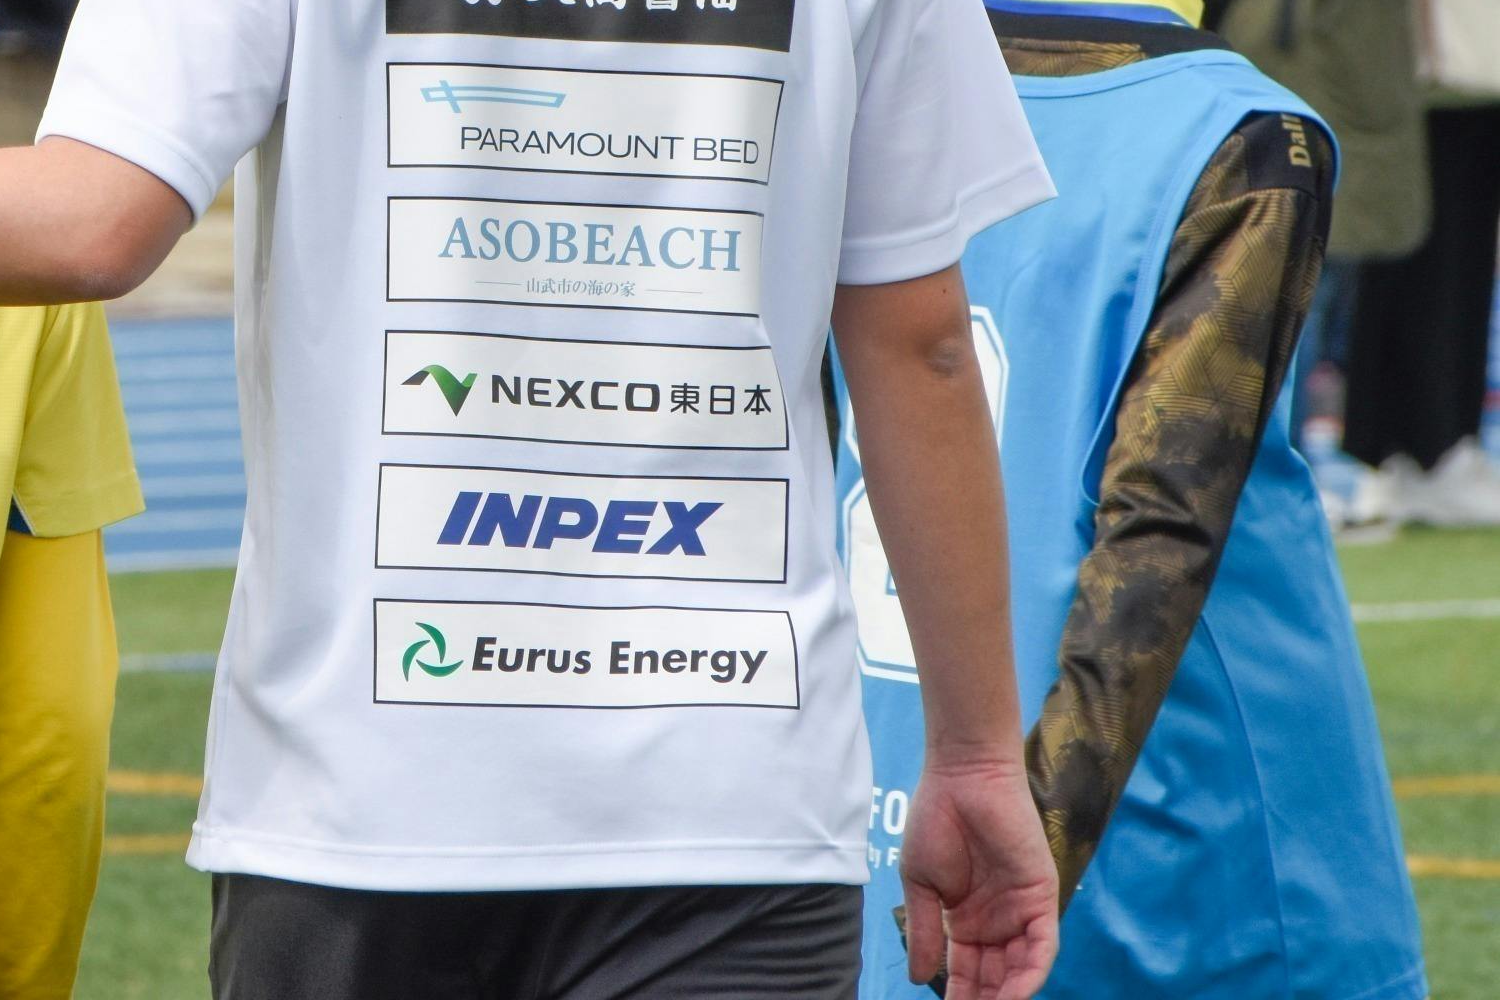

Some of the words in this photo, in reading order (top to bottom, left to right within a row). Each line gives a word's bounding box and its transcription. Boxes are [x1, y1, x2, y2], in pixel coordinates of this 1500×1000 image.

[461, 126, 685, 160] PARAMOUNT
[693, 137, 760, 165] BED
[438, 217, 742, 272] ASOBEACH
[526, 277, 636, 298] 山武市の海の家
[436, 491, 725, 556] INPEX
[472, 636, 592, 675] Eurus
[609, 641, 768, 684] Energy
